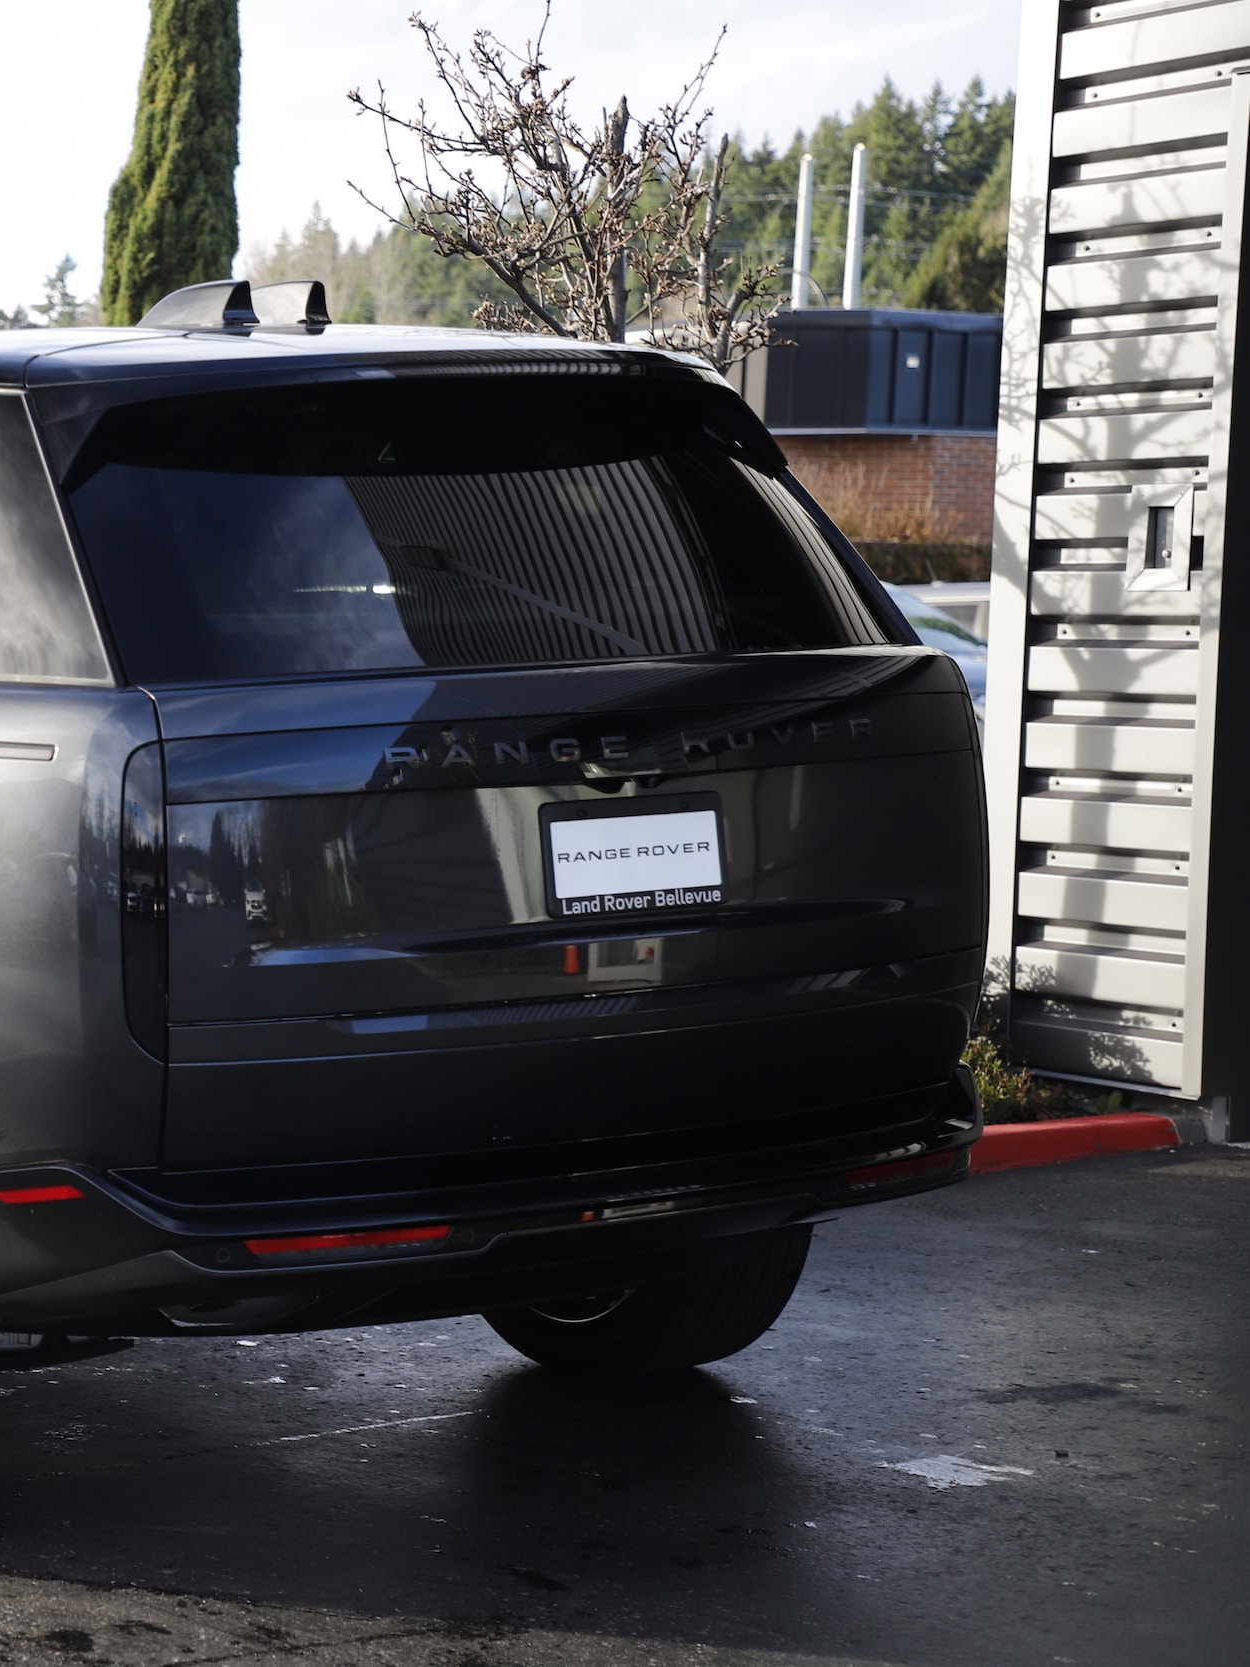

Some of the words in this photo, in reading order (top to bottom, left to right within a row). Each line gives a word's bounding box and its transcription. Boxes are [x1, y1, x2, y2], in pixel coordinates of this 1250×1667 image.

[384, 735, 630, 769] RANGE
[558, 848, 631, 863] RANGE
[637, 841, 710, 857] ROVER
[562, 895, 600, 915] Land
[604, 895, 650, 911] Rover
[654, 889, 722, 907] Bellevue
